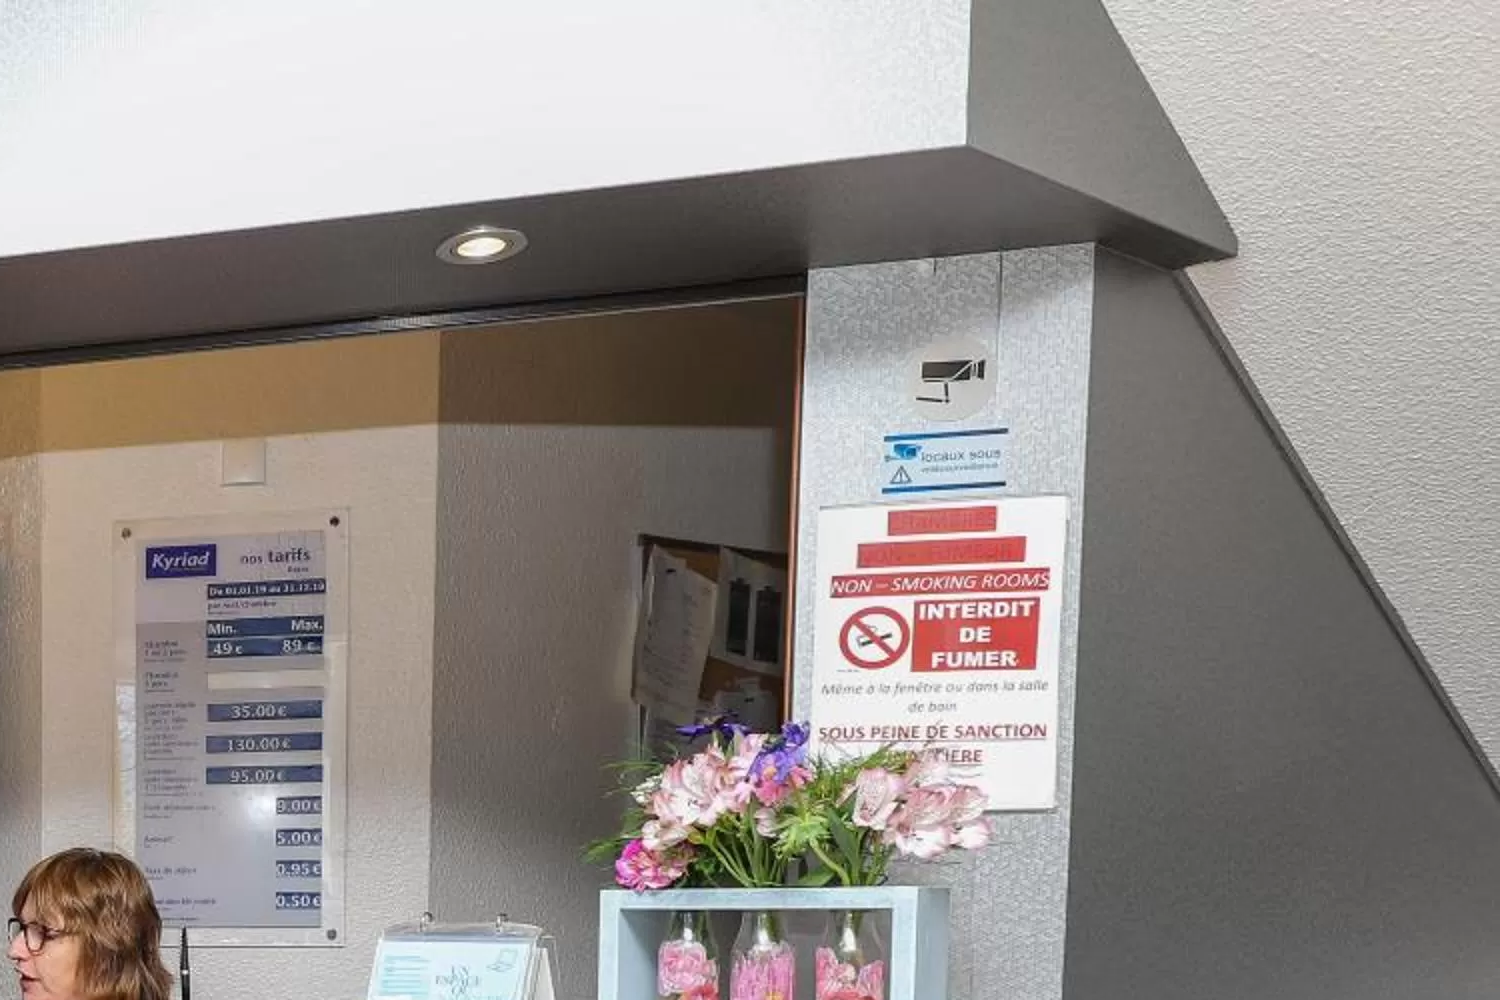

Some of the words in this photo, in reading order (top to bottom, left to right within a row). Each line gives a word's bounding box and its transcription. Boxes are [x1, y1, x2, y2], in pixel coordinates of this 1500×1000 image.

[922, 451, 965, 463] locaux
[969, 449, 1001, 460] sous
[152, 551, 211, 571] Kyriad
[241, 553, 263, 565] nos
[268, 548, 312, 564] tarifs
[831, 578, 873, 594] NON
[891, 574, 978, 592] SMOKING
[981, 570, 1050, 589] ROOMS
[919, 601, 1035, 621] INTERDIT
[207, 622, 237, 635] Min.
[291, 619, 323, 632] Max.
[959, 627, 993, 644] DE
[931, 650, 1017, 668] FUMER
[821, 683, 864, 695] Même
[879, 682, 891, 694] la
[893, 681, 941, 698] fenêtre
[945, 684, 963, 694] ou
[966, 680, 998, 693] dans
[1002, 680, 1016, 692] la
[1019, 679, 1049, 692] salle
[908, 701, 926, 713] de
[928, 700, 957, 713] bain
[819, 726, 866, 741] SOUS
[870, 726, 920, 740] PEINE
[926, 724, 949, 739] DE
[954, 724, 1048, 739] SANCTION
